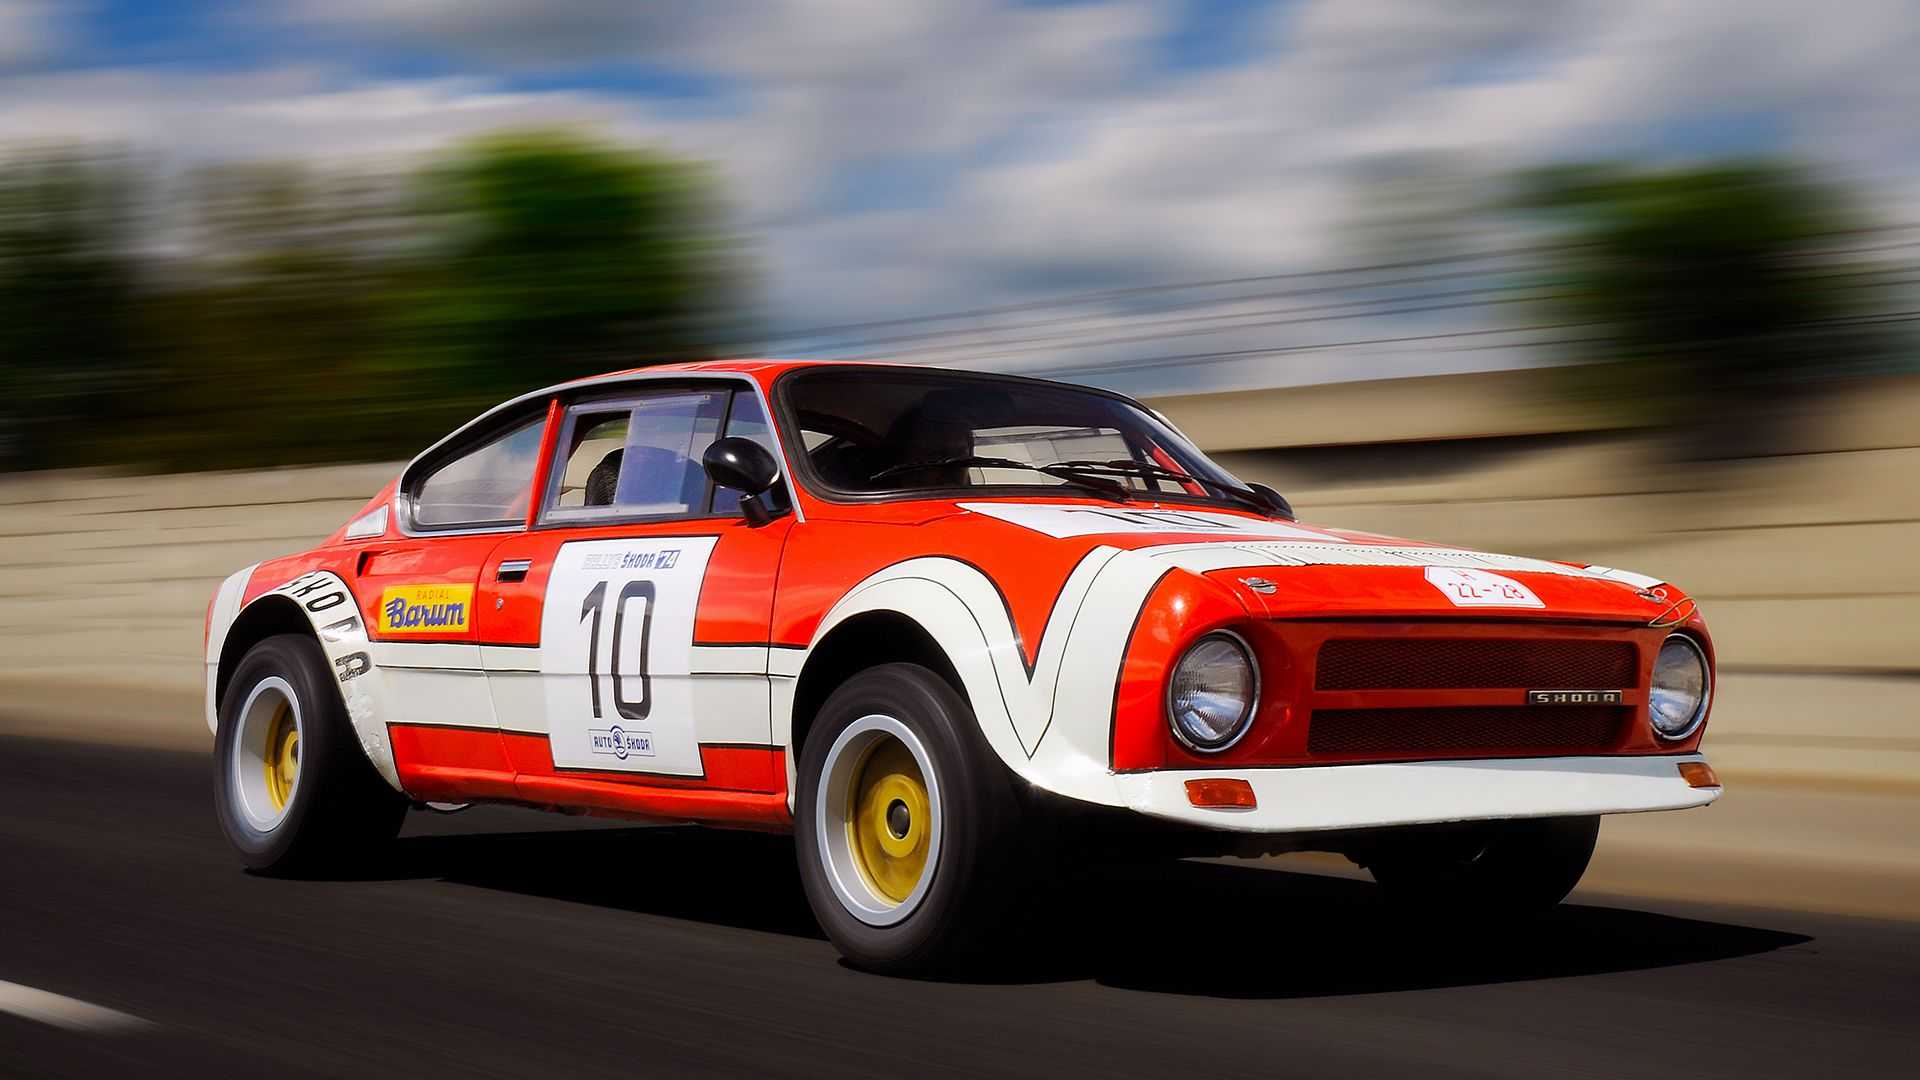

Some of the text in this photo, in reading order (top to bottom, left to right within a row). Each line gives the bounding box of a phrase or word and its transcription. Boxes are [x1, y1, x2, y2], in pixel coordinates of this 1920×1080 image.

[416, 590, 449, 600] RADIAL
[1448, 582, 1525, 599] 22-28
[385, 597, 464, 628] Barum
[580, 580, 656, 720] 10
[594, 736, 612, 748] AUTO
